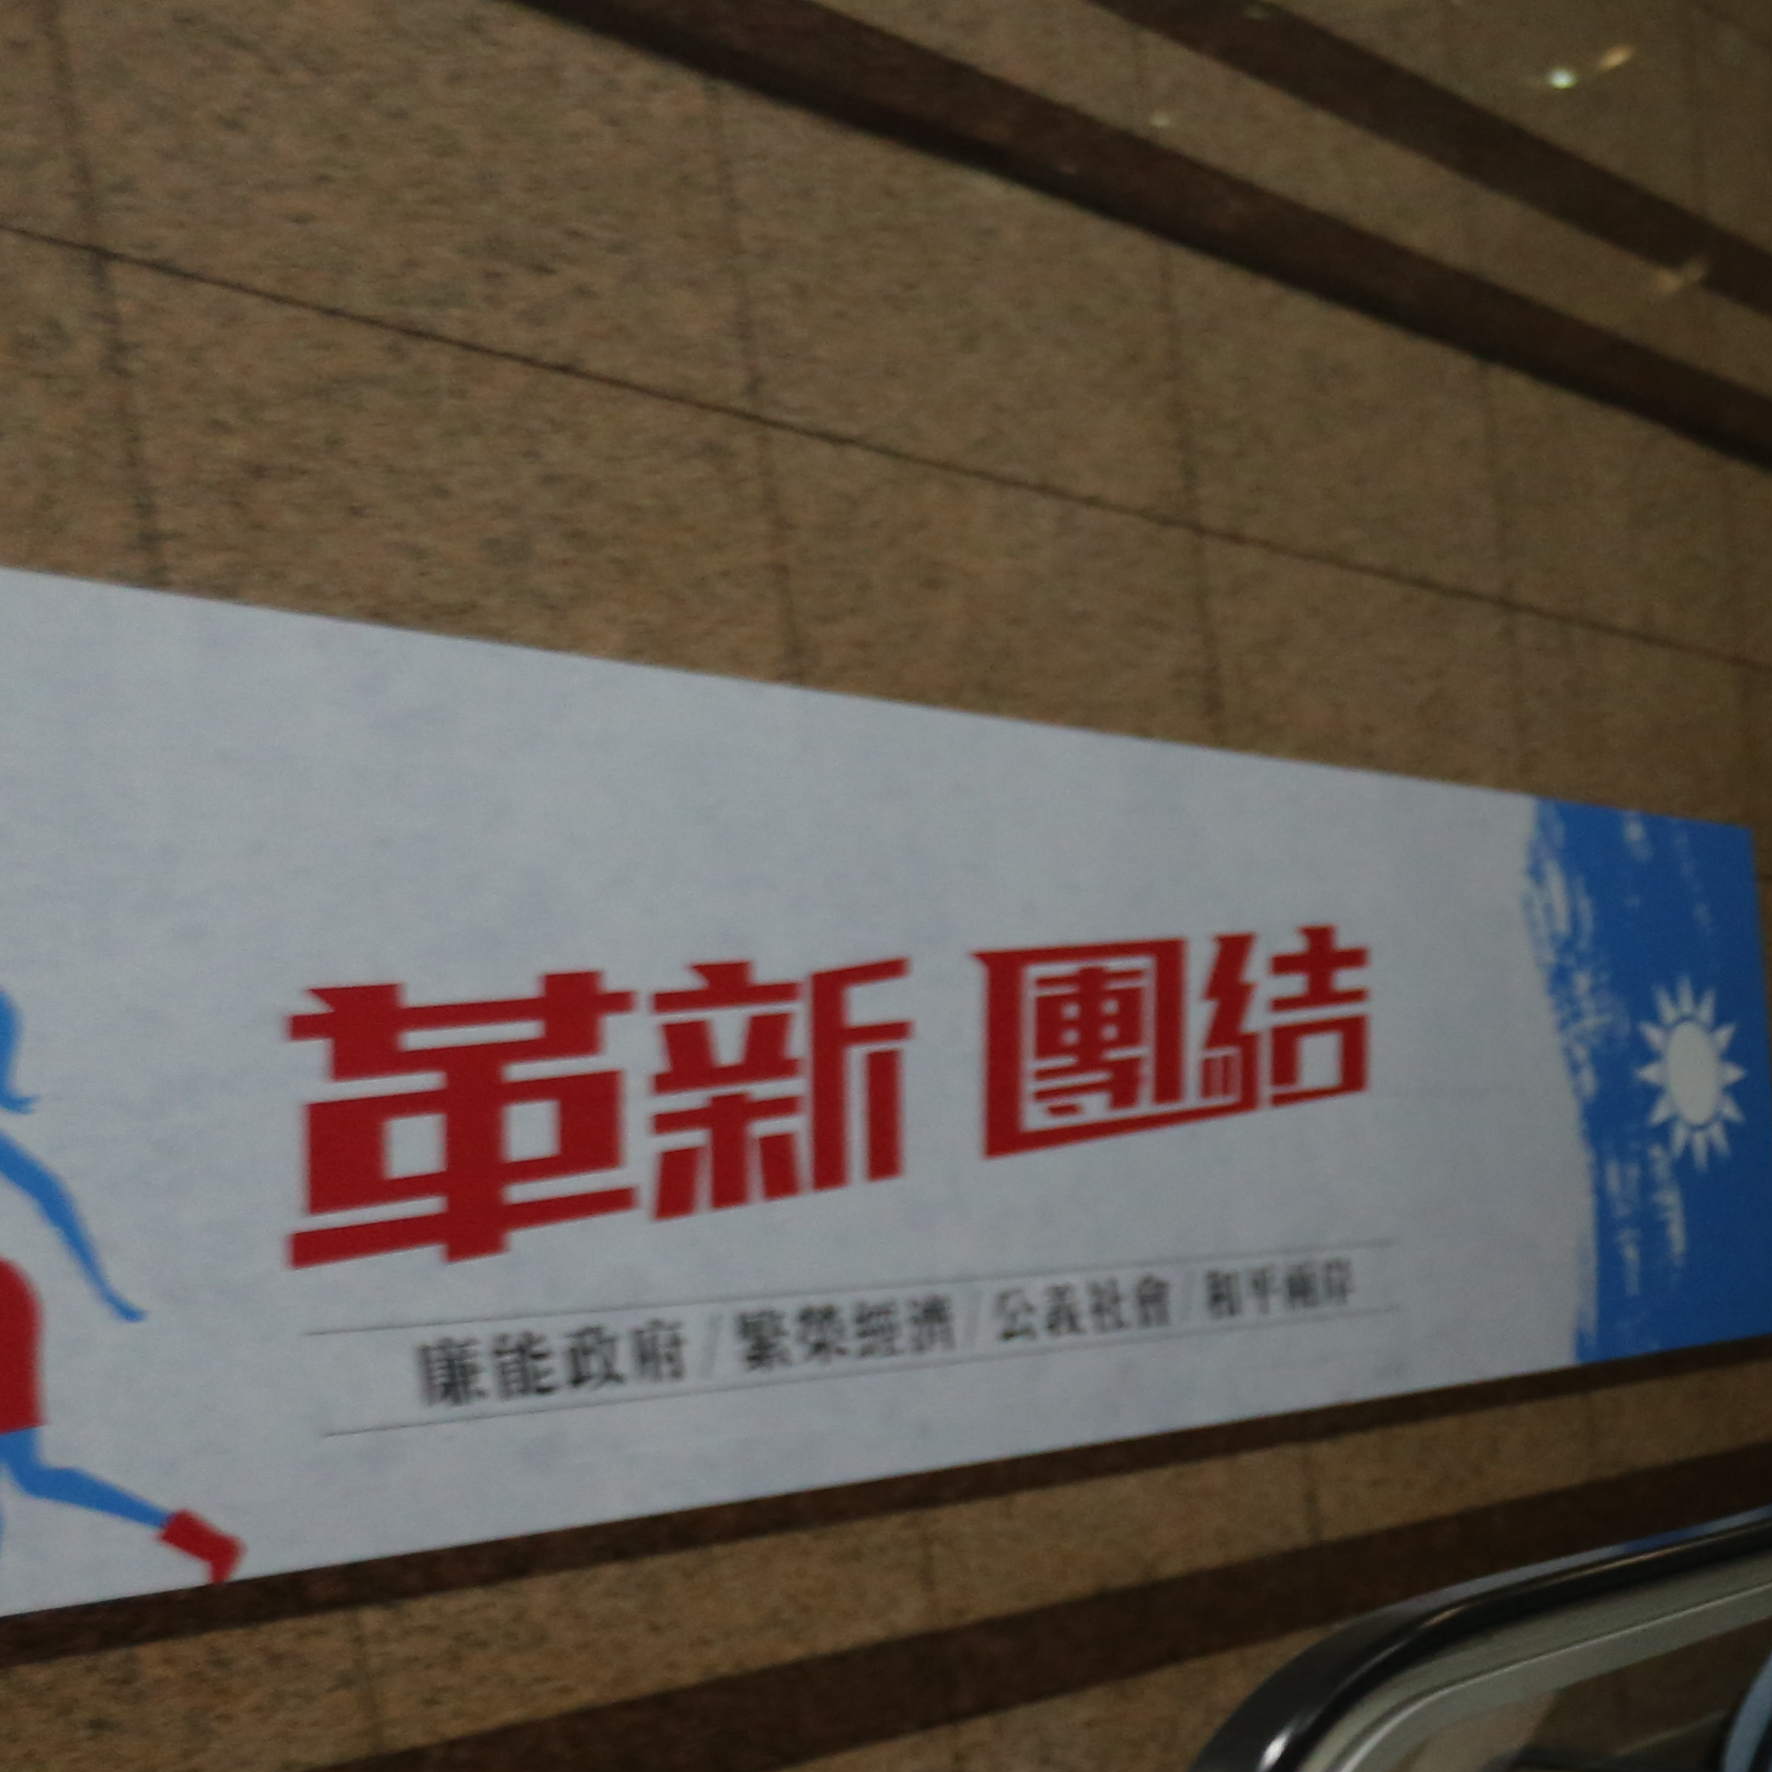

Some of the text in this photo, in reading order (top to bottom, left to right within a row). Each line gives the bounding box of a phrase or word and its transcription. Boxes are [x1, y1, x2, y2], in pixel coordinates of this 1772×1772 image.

[289, 925, 1368, 1268] 革新 團結
[416, 1318, 686, 1405] 廉能政府
[738, 1294, 957, 1371] 繁榮經濟
[996, 1272, 1170, 1340] 公義社會
